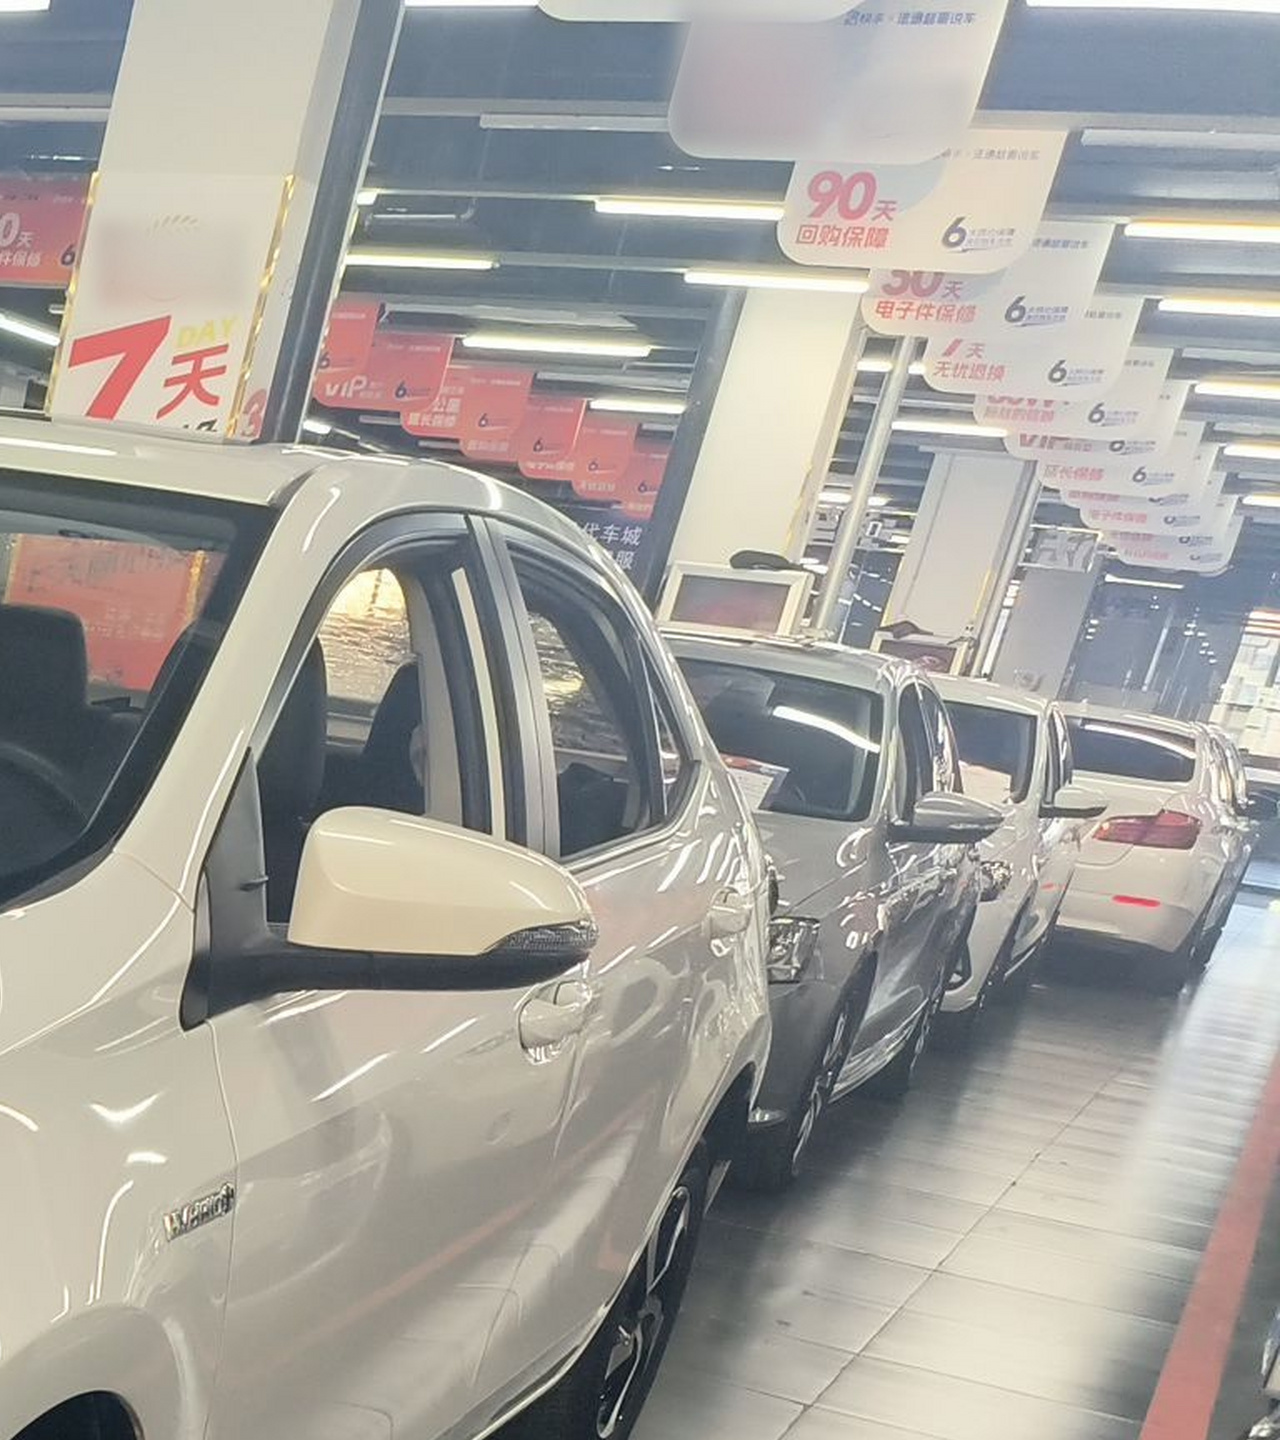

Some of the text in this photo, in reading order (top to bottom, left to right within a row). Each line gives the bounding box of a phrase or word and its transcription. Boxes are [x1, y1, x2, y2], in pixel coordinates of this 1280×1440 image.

[807, 170, 898, 221] 90天
[796, 224, 889, 248] 回购保障
[942, 217, 967, 248] 6
[875, 300, 977, 323] 电子件保修
[1004, 296, 1026, 323] 6
[175, 315, 237, 348] DAY
[68, 315, 229, 420] 7天
[934, 361, 1006, 381] 无忧退换
[325, 375, 367, 398] VIP
